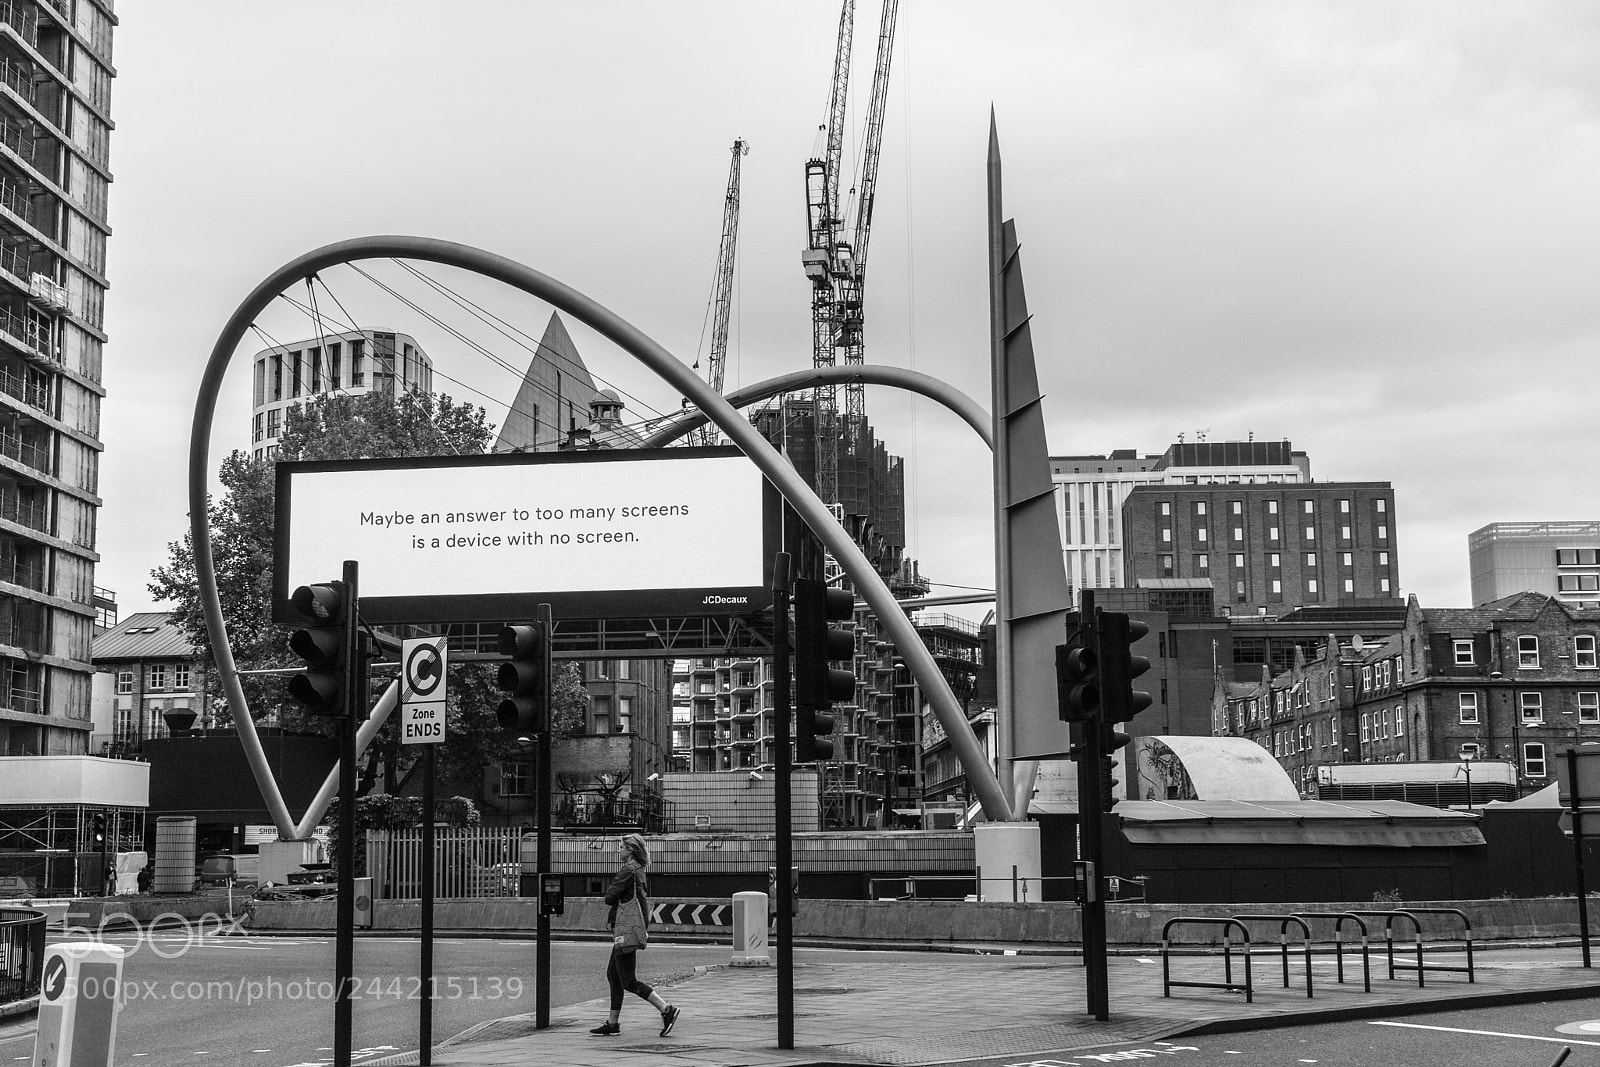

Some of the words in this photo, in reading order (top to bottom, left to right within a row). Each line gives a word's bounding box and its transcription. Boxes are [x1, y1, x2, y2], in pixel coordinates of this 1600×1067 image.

[360, 511, 415, 529] Maybe
[420, 513, 440, 524] an
[446, 511, 507, 524] answer
[512, 508, 530, 521] to
[535, 507, 564, 520] too
[570, 507, 616, 522] many
[621, 504, 689, 518] screens
[412, 534, 425, 549] is
[431, 537, 440, 549] a
[446, 532, 501, 548] device
[507, 531, 543, 546] with
[550, 533, 570, 545] no
[576, 531, 639, 544] screen.
[702, 595, 748, 604] JCDecaux
[412, 708, 435, 720] Zone
[406, 722, 441, 737] ENDS
